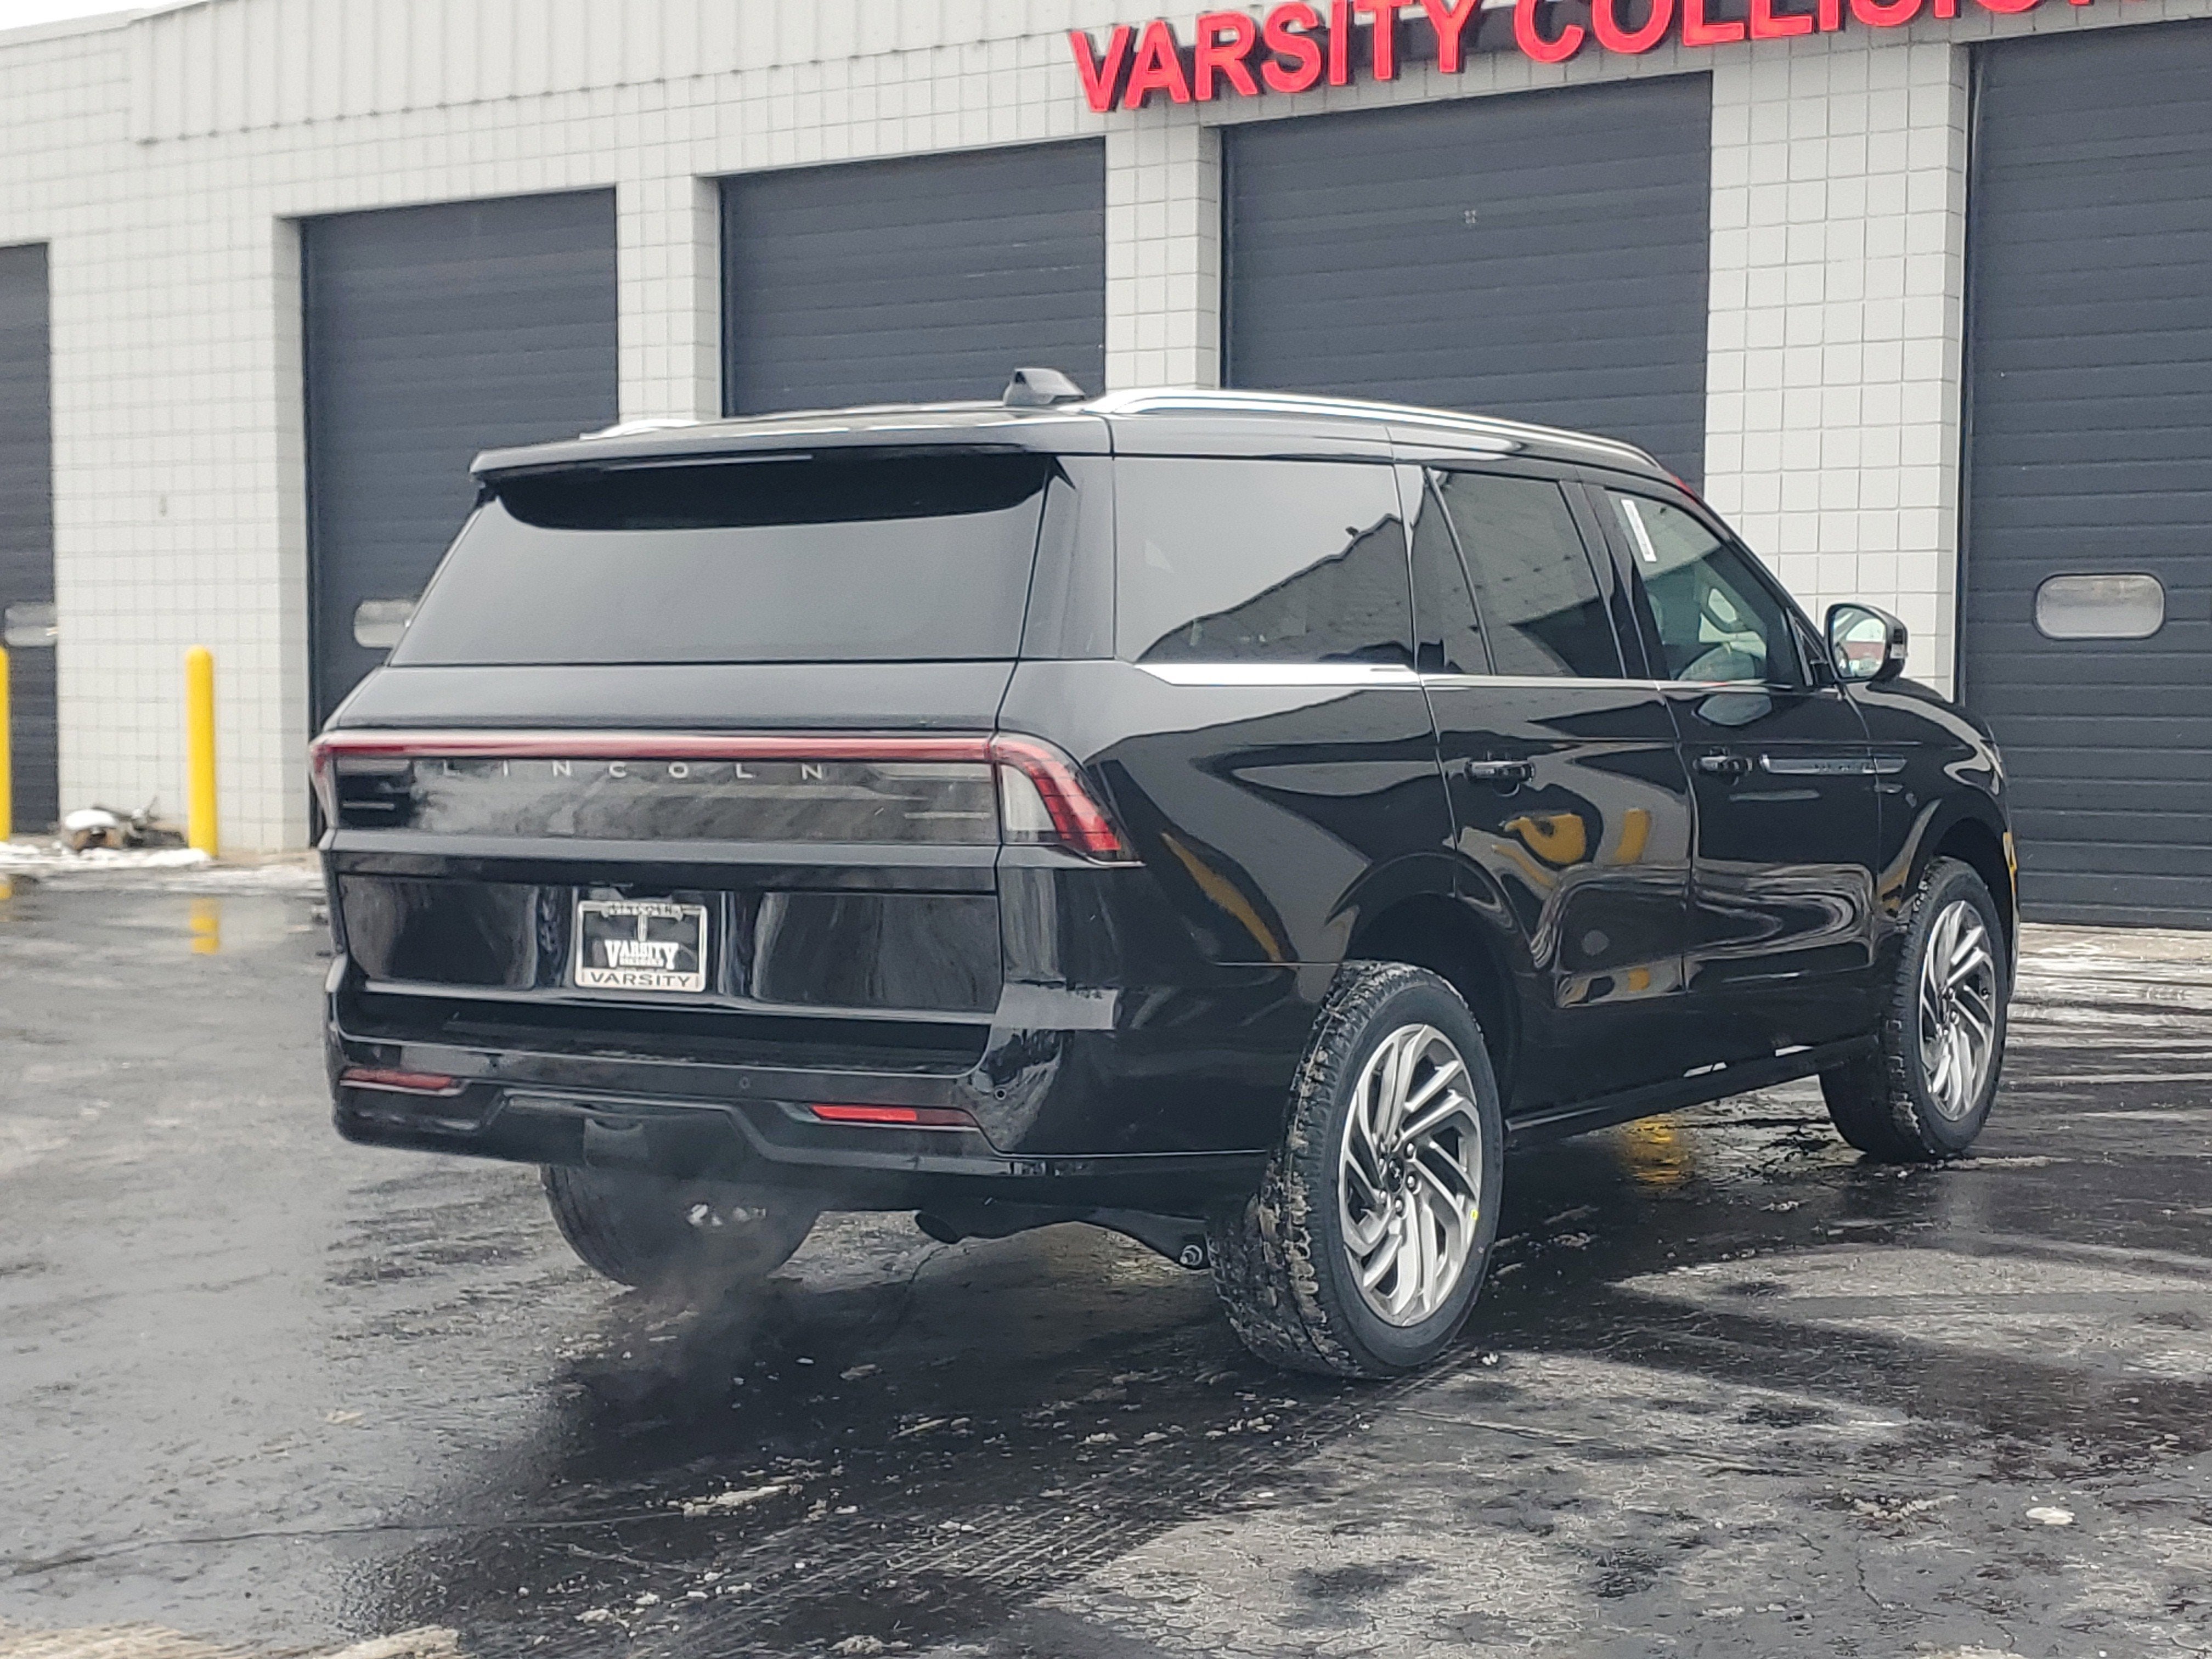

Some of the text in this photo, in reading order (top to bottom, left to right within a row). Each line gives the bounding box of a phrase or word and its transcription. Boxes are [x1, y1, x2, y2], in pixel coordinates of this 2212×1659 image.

[1069, 0, 1476, 112] VARSITY
[442, 759, 823, 780] LINCOLN
[605, 939, 679, 970] VARSITY
[590, 971, 691, 988] VARSITY
